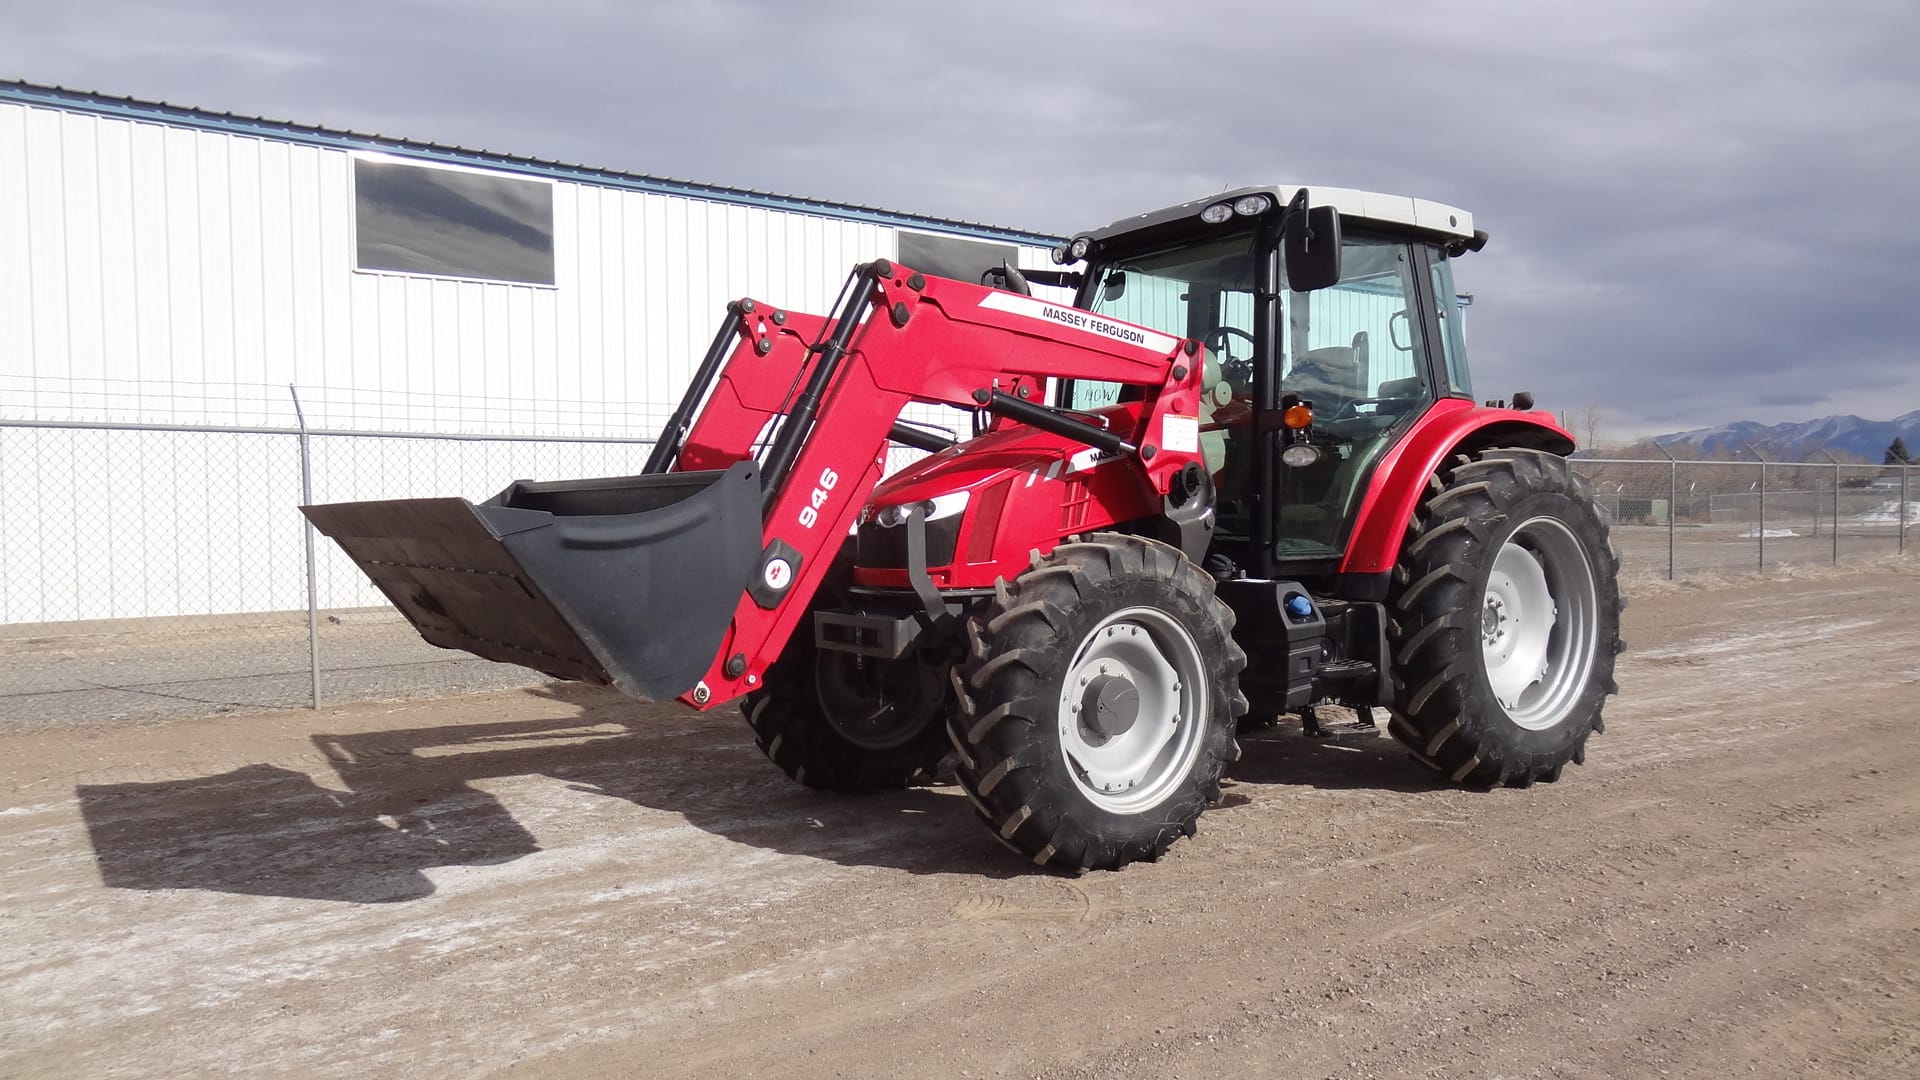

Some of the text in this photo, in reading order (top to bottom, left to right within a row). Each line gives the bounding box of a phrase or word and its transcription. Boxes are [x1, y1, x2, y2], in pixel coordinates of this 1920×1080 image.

[1043, 306, 1145, 344] MASSEY FERGUSON
[798, 467, 839, 529] 946
